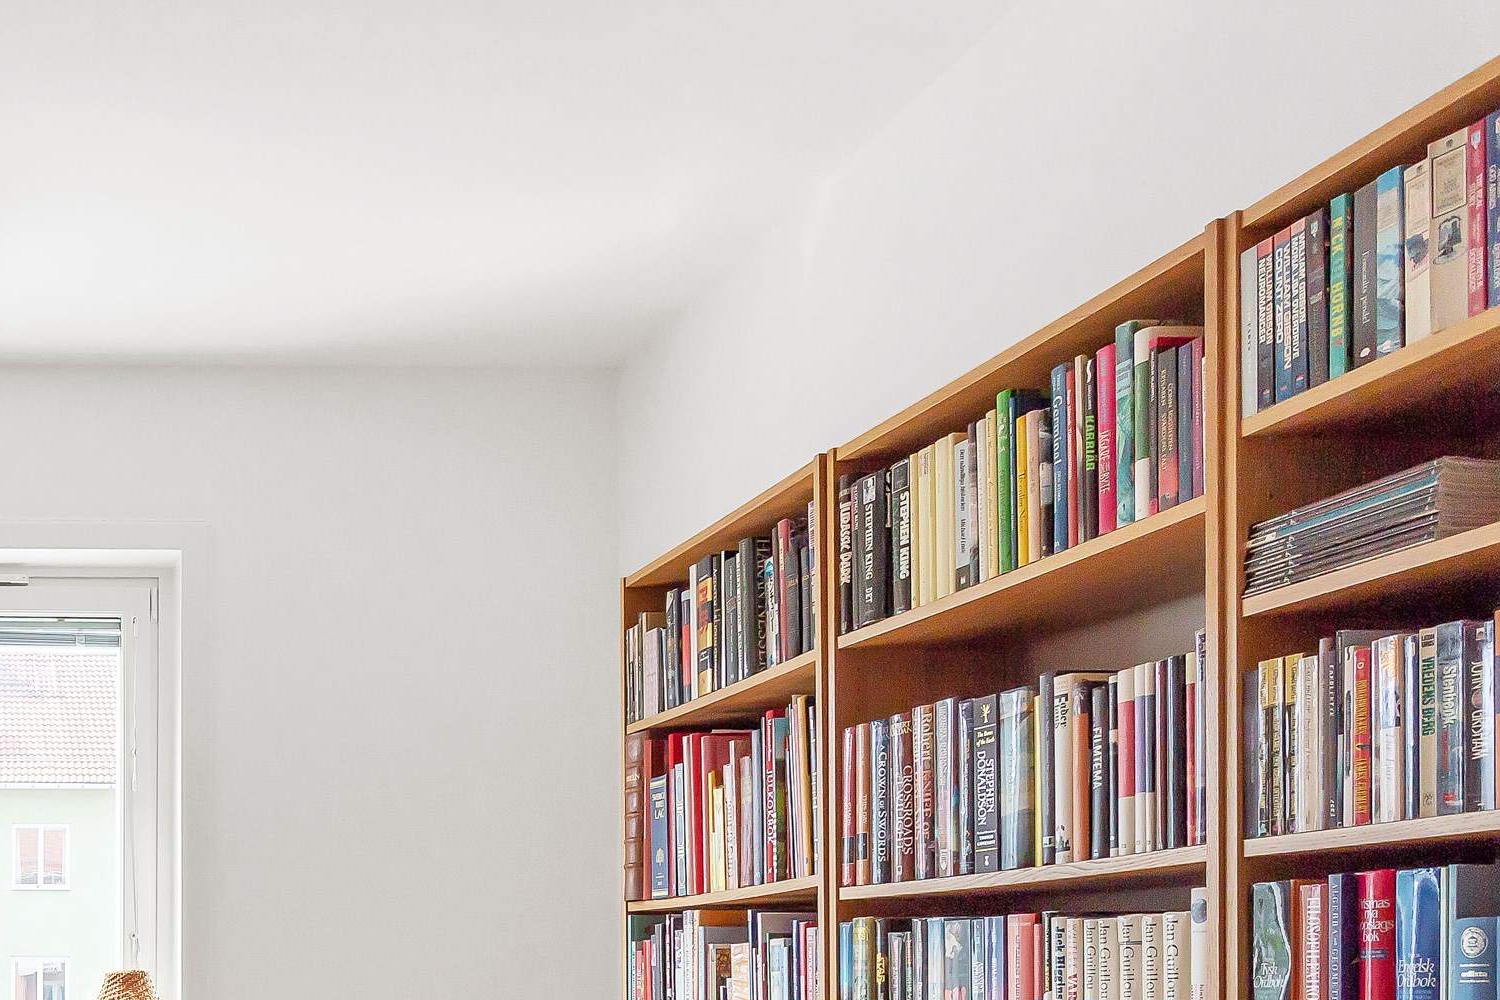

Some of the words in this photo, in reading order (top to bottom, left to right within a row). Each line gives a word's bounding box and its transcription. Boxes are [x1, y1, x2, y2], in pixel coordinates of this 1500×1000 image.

[1292, 236, 1300, 270] MONA
[1298, 234, 1306, 278] WILLIAM
[1330, 216, 1346, 256] NICK
[1266, 254, 1274, 298] WILLIAM
[1276, 248, 1284, 302] COUNT
[1284, 244, 1292, 308] WILLIAM
[1360, 252, 1370, 294] Foucaults
[1258, 258, 1266, 344] NEUROMANCER
[1266, 300, 1274, 344] GIBSON
[1298, 280, 1306, 324] GIBSON
[1330, 282, 1346, 346] HORNBY
[1358, 296, 1370, 324] pendel
[1276, 304, 1284, 344] ZERO
[1284, 310, 1292, 370] GIBSON
[1292, 298, 1300, 360] OVERDRIVE
[1052, 396, 1064, 466] Germinal
[1086, 414, 1096, 470] KARRIÄR
[1098, 430, 1112, 460] JÄGARE
[1098, 472, 1112, 494] BYTE
[840, 502, 852, 552] JURASSIC
[864, 504, 874, 552] STEPHEN
[898, 492, 910, 546] STEPHEN
[840, 552, 852, 586] PARK
[864, 554, 874, 580] KING
[898, 546, 910, 580] KING
[864, 586, 874, 604] DET
[1421, 656, 1436, 706] VREDENS
[1470, 660, 1486, 690] JOHN
[922, 712, 934, 760] Robert
[1421, 706, 1436, 736] BERG
[1470, 708, 1486, 760] GRISHAM
[878, 752, 888, 798] CROWN
[1092, 726, 1102, 790] FILMTEMA
[922, 768, 934, 818] KNIFE
[977, 750, 986, 826] DONALDSON
[986, 758, 995, 814] STEPHEN
[903, 764, 914, 854] CROSSROADS
[922, 822, 934, 840] OF
[878, 810, 888, 862] SWORDS
[1054, 926, 1066, 952] Jack
[1086, 924, 1096, 942] Jan
[1100, 922, 1110, 944] Jan
[1122, 922, 1134, 944] Jan
[1145, 921, 1158, 942] Jan
[1166, 918, 1178, 940] Jan
[1362, 930, 1380, 942] bok
[1054, 956, 1066, 1000] Higgins
[1086, 944, 1096, 990] Guillou
[1100, 946, 1110, 999] Guillou
[1122, 946, 1134, 998] Guillou
[1145, 946, 1158, 998] Guillou
[1166, 944, 1178, 998] Guillou
[1254, 970, 1286, 988] Ordbok
[1260, 961, 1278, 976] Tysk
[1397, 972, 1436, 988] Ordbok
